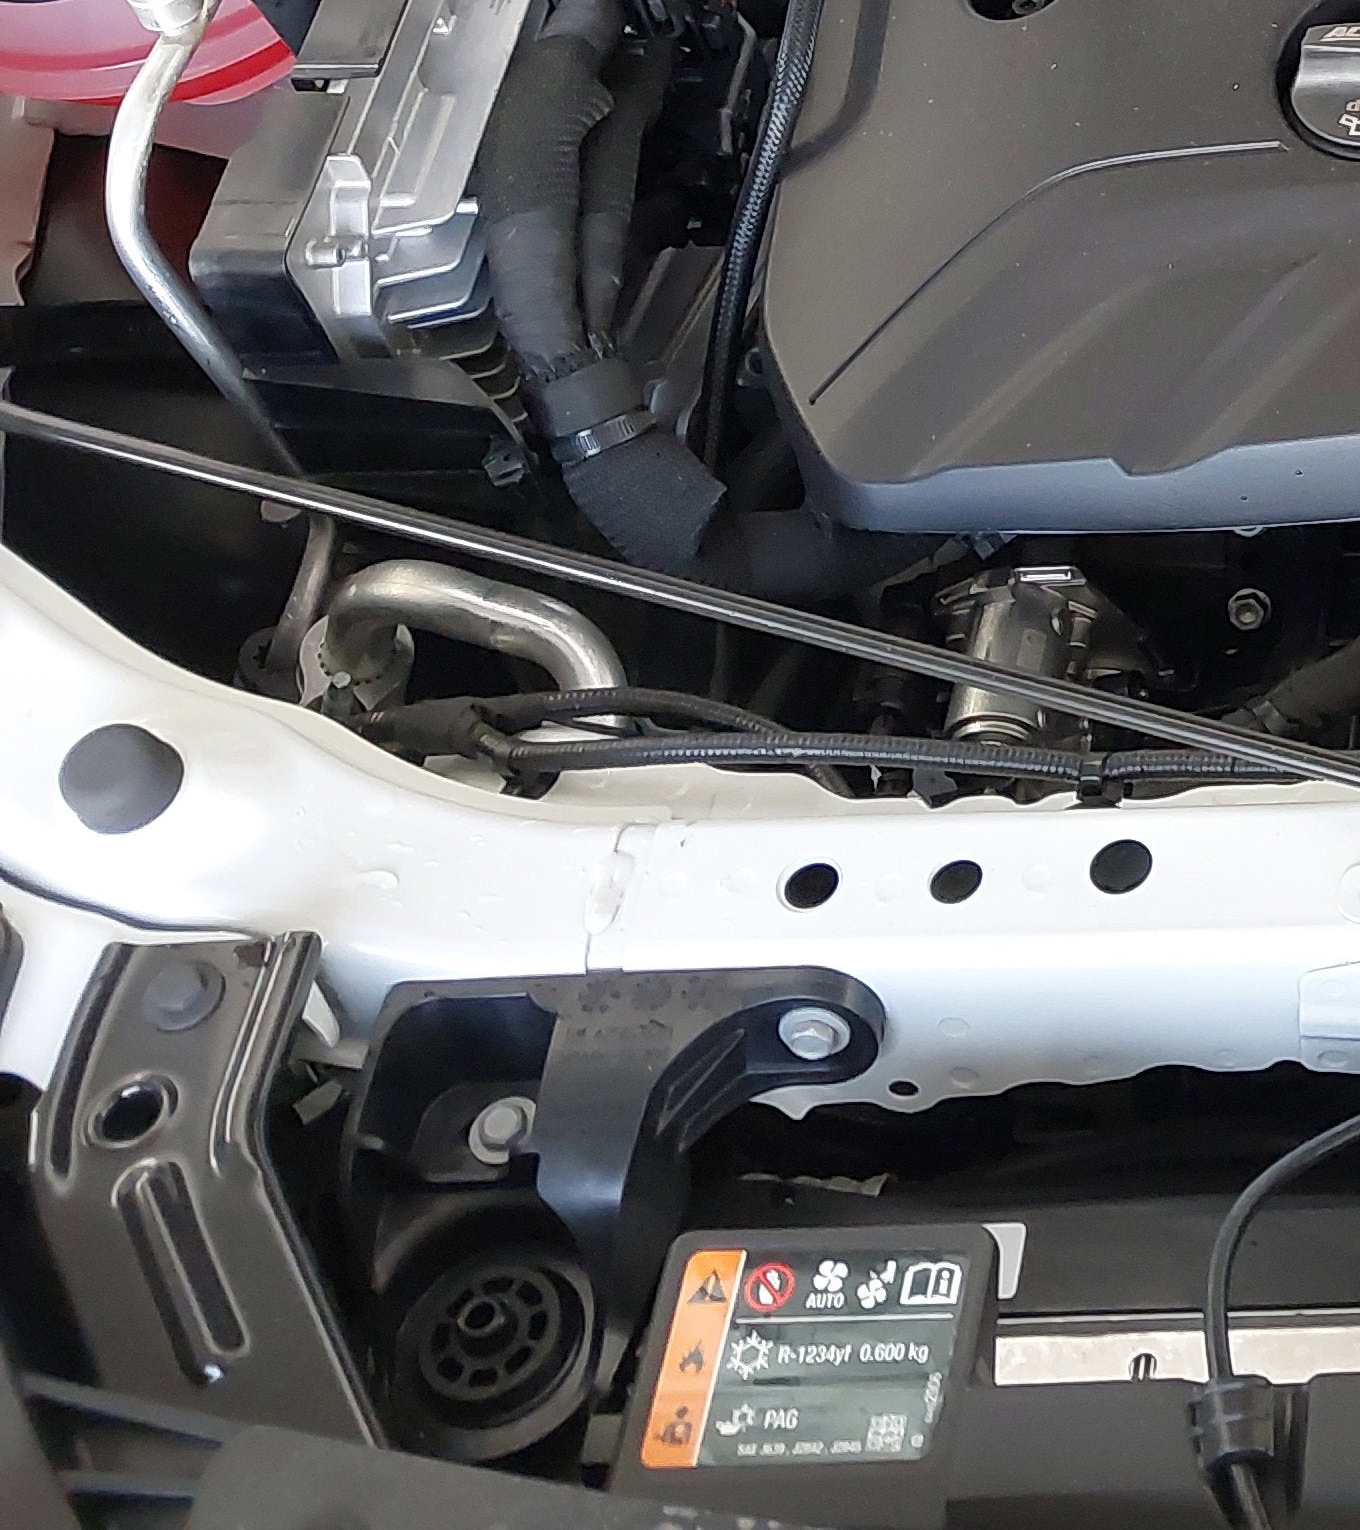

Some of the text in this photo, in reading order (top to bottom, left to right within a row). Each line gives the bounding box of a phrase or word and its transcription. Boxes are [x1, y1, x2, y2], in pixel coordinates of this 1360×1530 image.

[805, 1292, 845, 1309] AUTO
[777, 1342, 930, 1366] R-1234yf 0.600 kg
[763, 1408, 799, 1430] PAG
